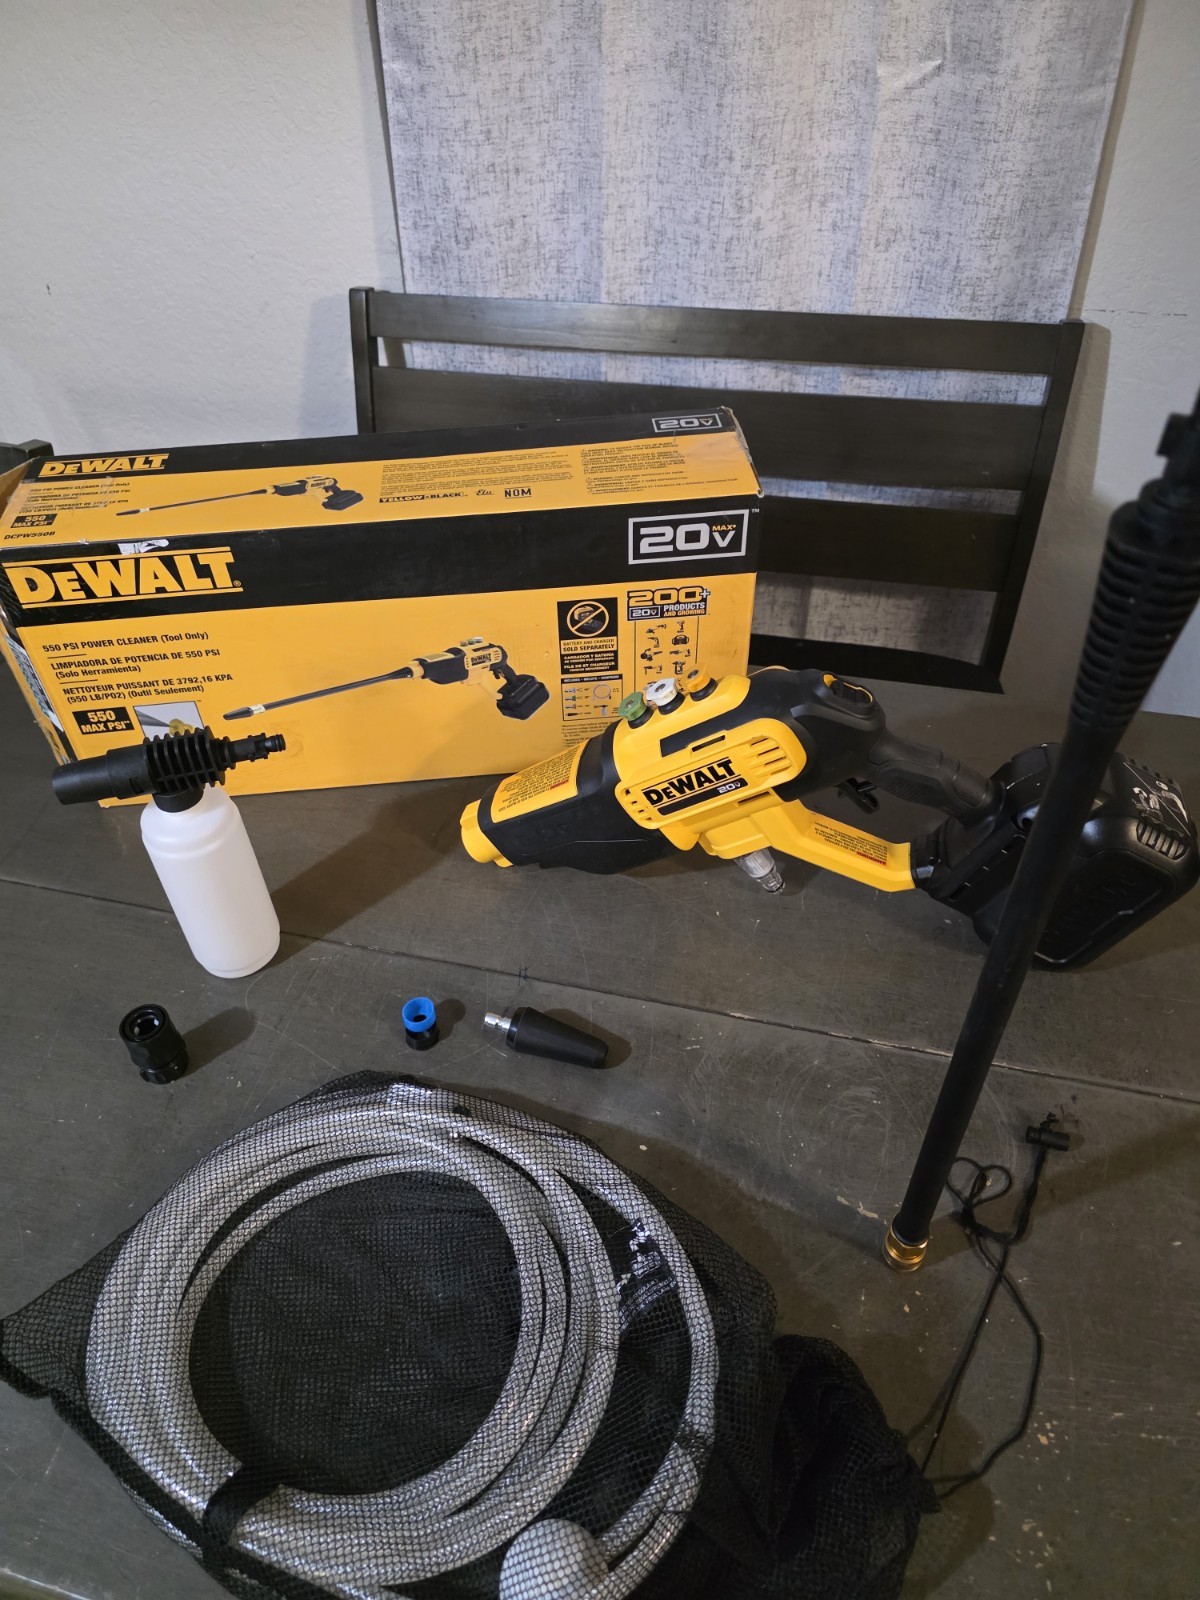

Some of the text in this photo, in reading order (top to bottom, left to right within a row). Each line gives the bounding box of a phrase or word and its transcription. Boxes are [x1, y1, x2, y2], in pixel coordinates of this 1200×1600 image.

[504, 487, 532, 498] NOM
[663, 602, 705, 612] PRODUCTS
[677, 608, 705, 616] GROWING
[42, 631, 209, 652] 550 PSI POWER CLEANER (Tool Only)
[580, 643, 615, 651] SEPARATELY
[51, 658, 108, 670] LIMPIADORA
[125, 653, 169, 664] POTENCIA
[185, 650, 203, 658] 550
[56, 665, 141, 680] (Solo Herramienta)
[63, 673, 233, 695] NETTOYEUR PUISSANT DE 3792,16 KPA
[67, 695, 87, 705] (550
[128, 688, 152, 699] (Outil
[154, 684, 205, 696] Seulement)
[87, 710, 116, 723] 550
[80, 722, 107, 733] MAX
